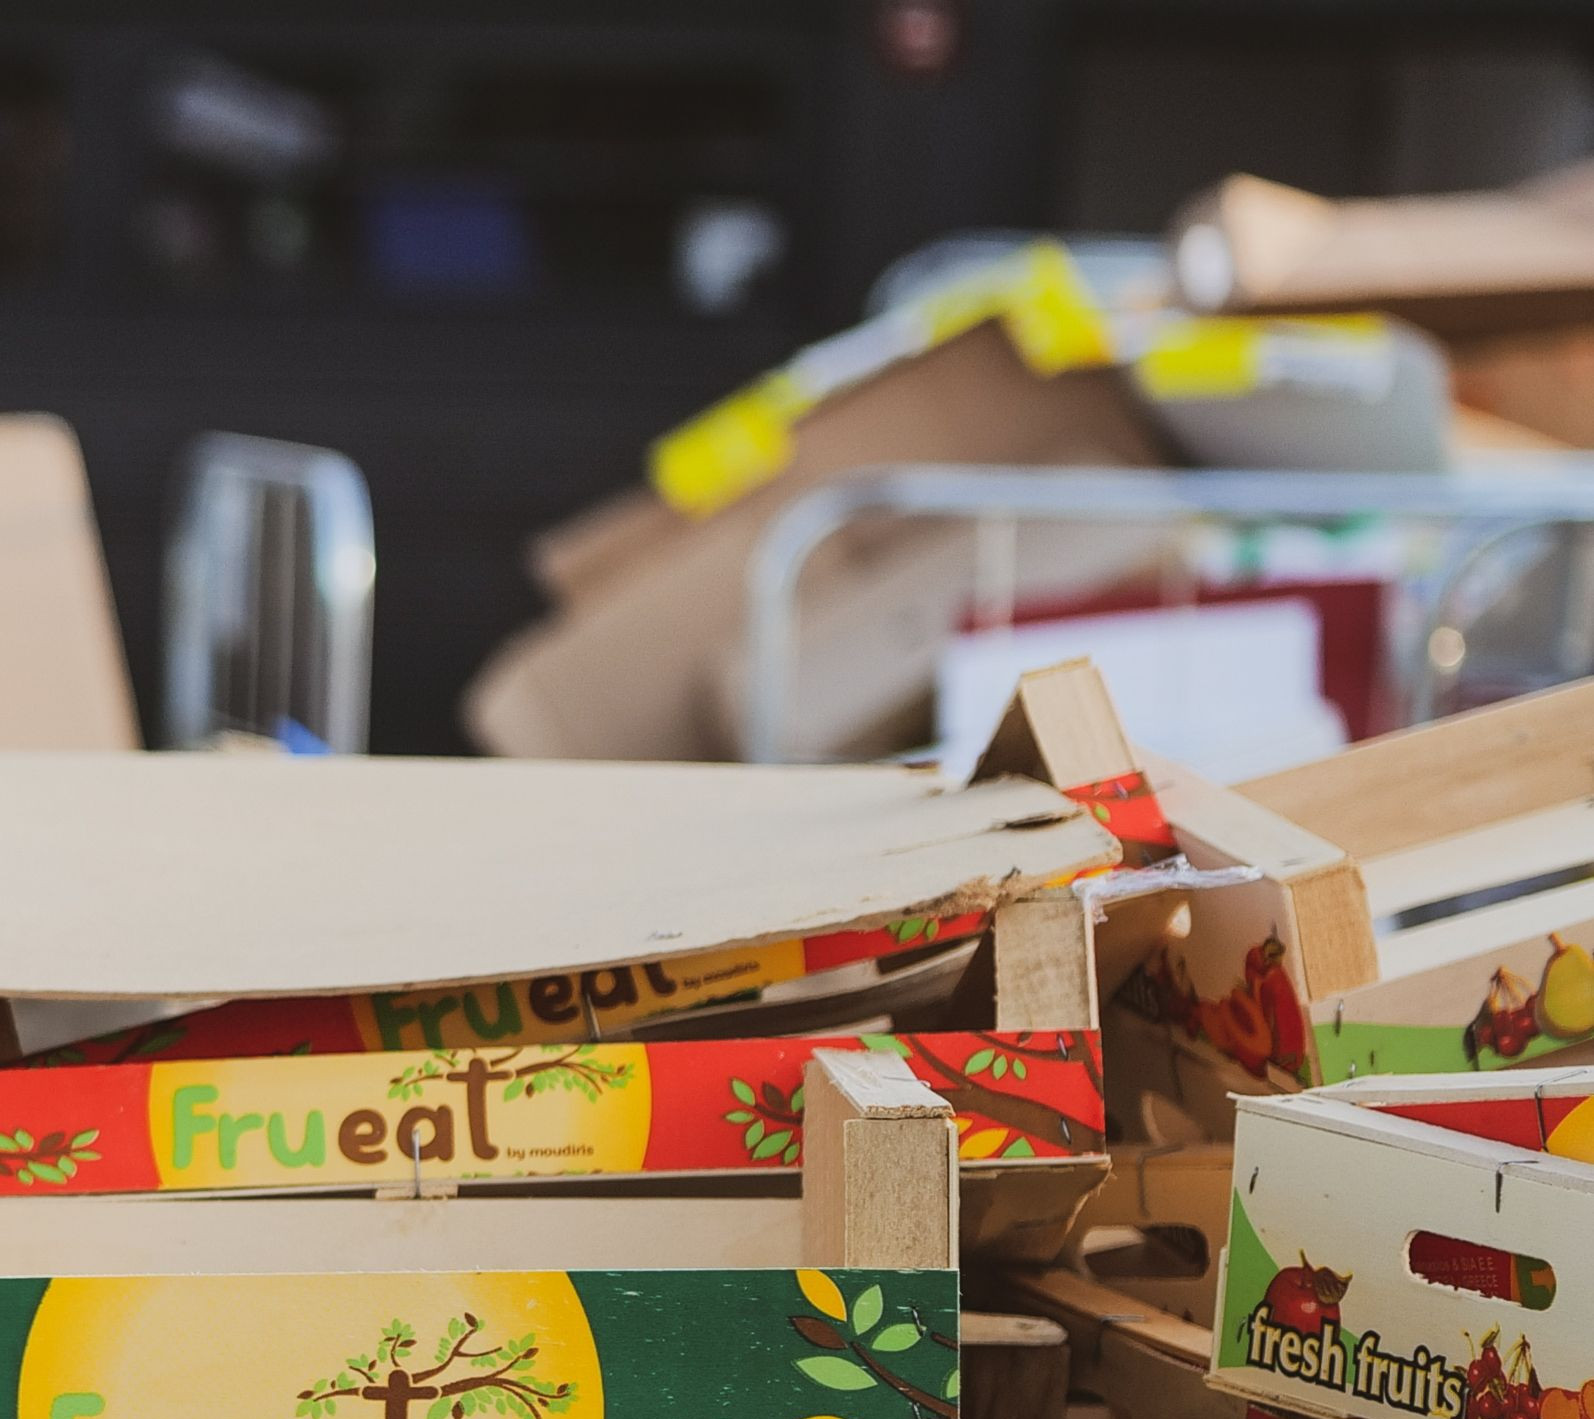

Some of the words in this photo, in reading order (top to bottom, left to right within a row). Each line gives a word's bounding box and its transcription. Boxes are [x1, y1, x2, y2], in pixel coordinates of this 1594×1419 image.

[172, 1057, 513, 1169] Frueat
[506, 1145, 525, 1160] by
[1247, 1311, 1346, 1391] fresh
